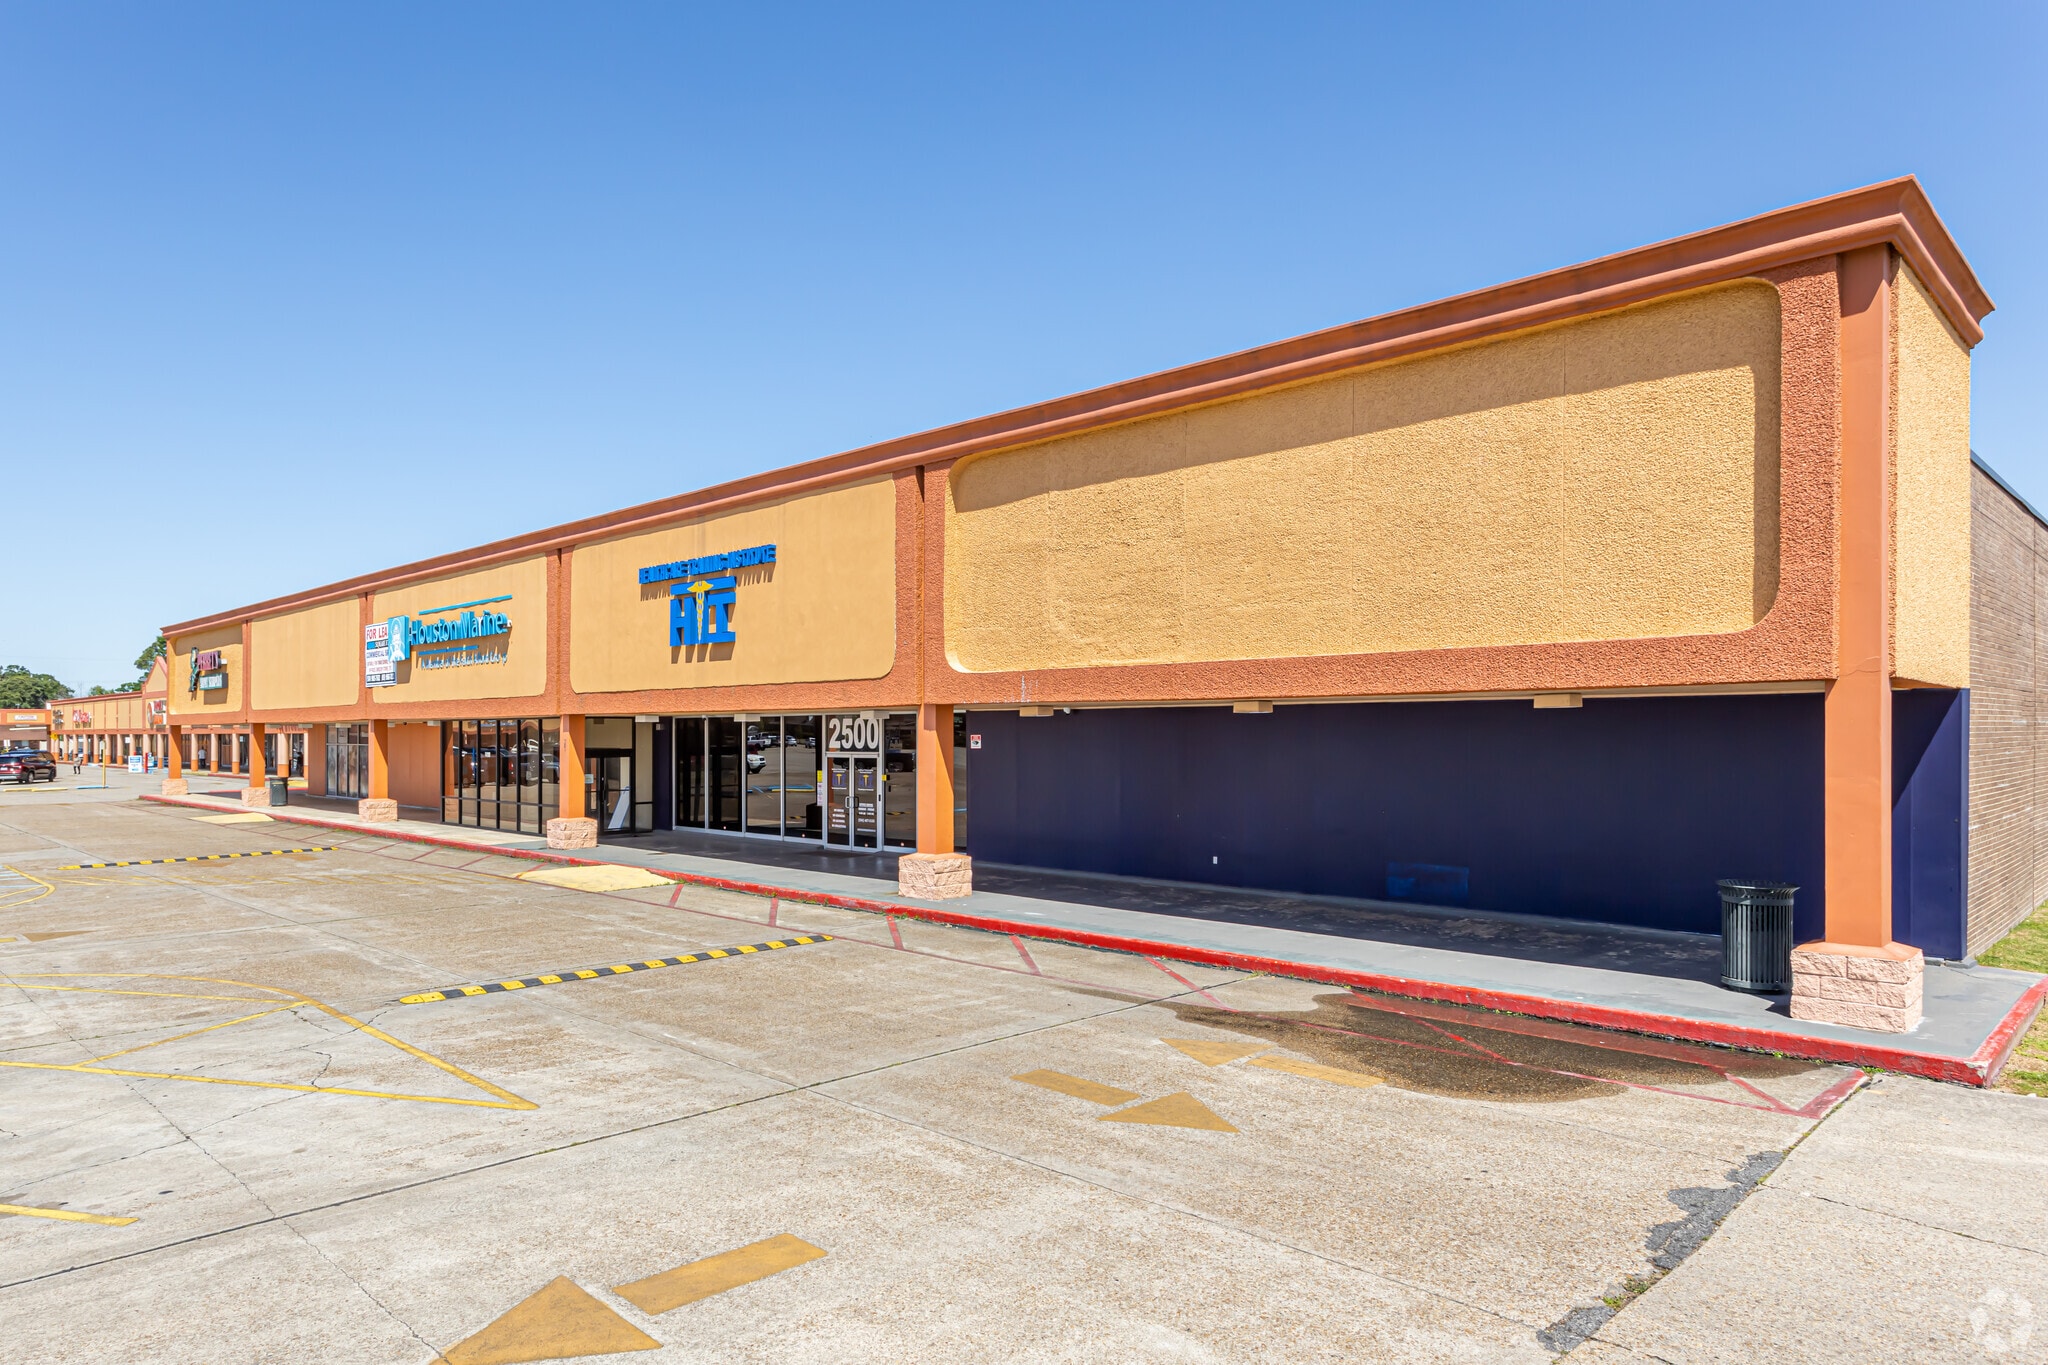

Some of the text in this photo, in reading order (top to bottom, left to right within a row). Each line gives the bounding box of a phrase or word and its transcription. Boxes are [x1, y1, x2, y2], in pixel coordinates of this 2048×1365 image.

[367, 627, 388, 640] FOR LEA
[410, 610, 509, 645] Houston Marine
[829, 718, 879, 749] 2500
